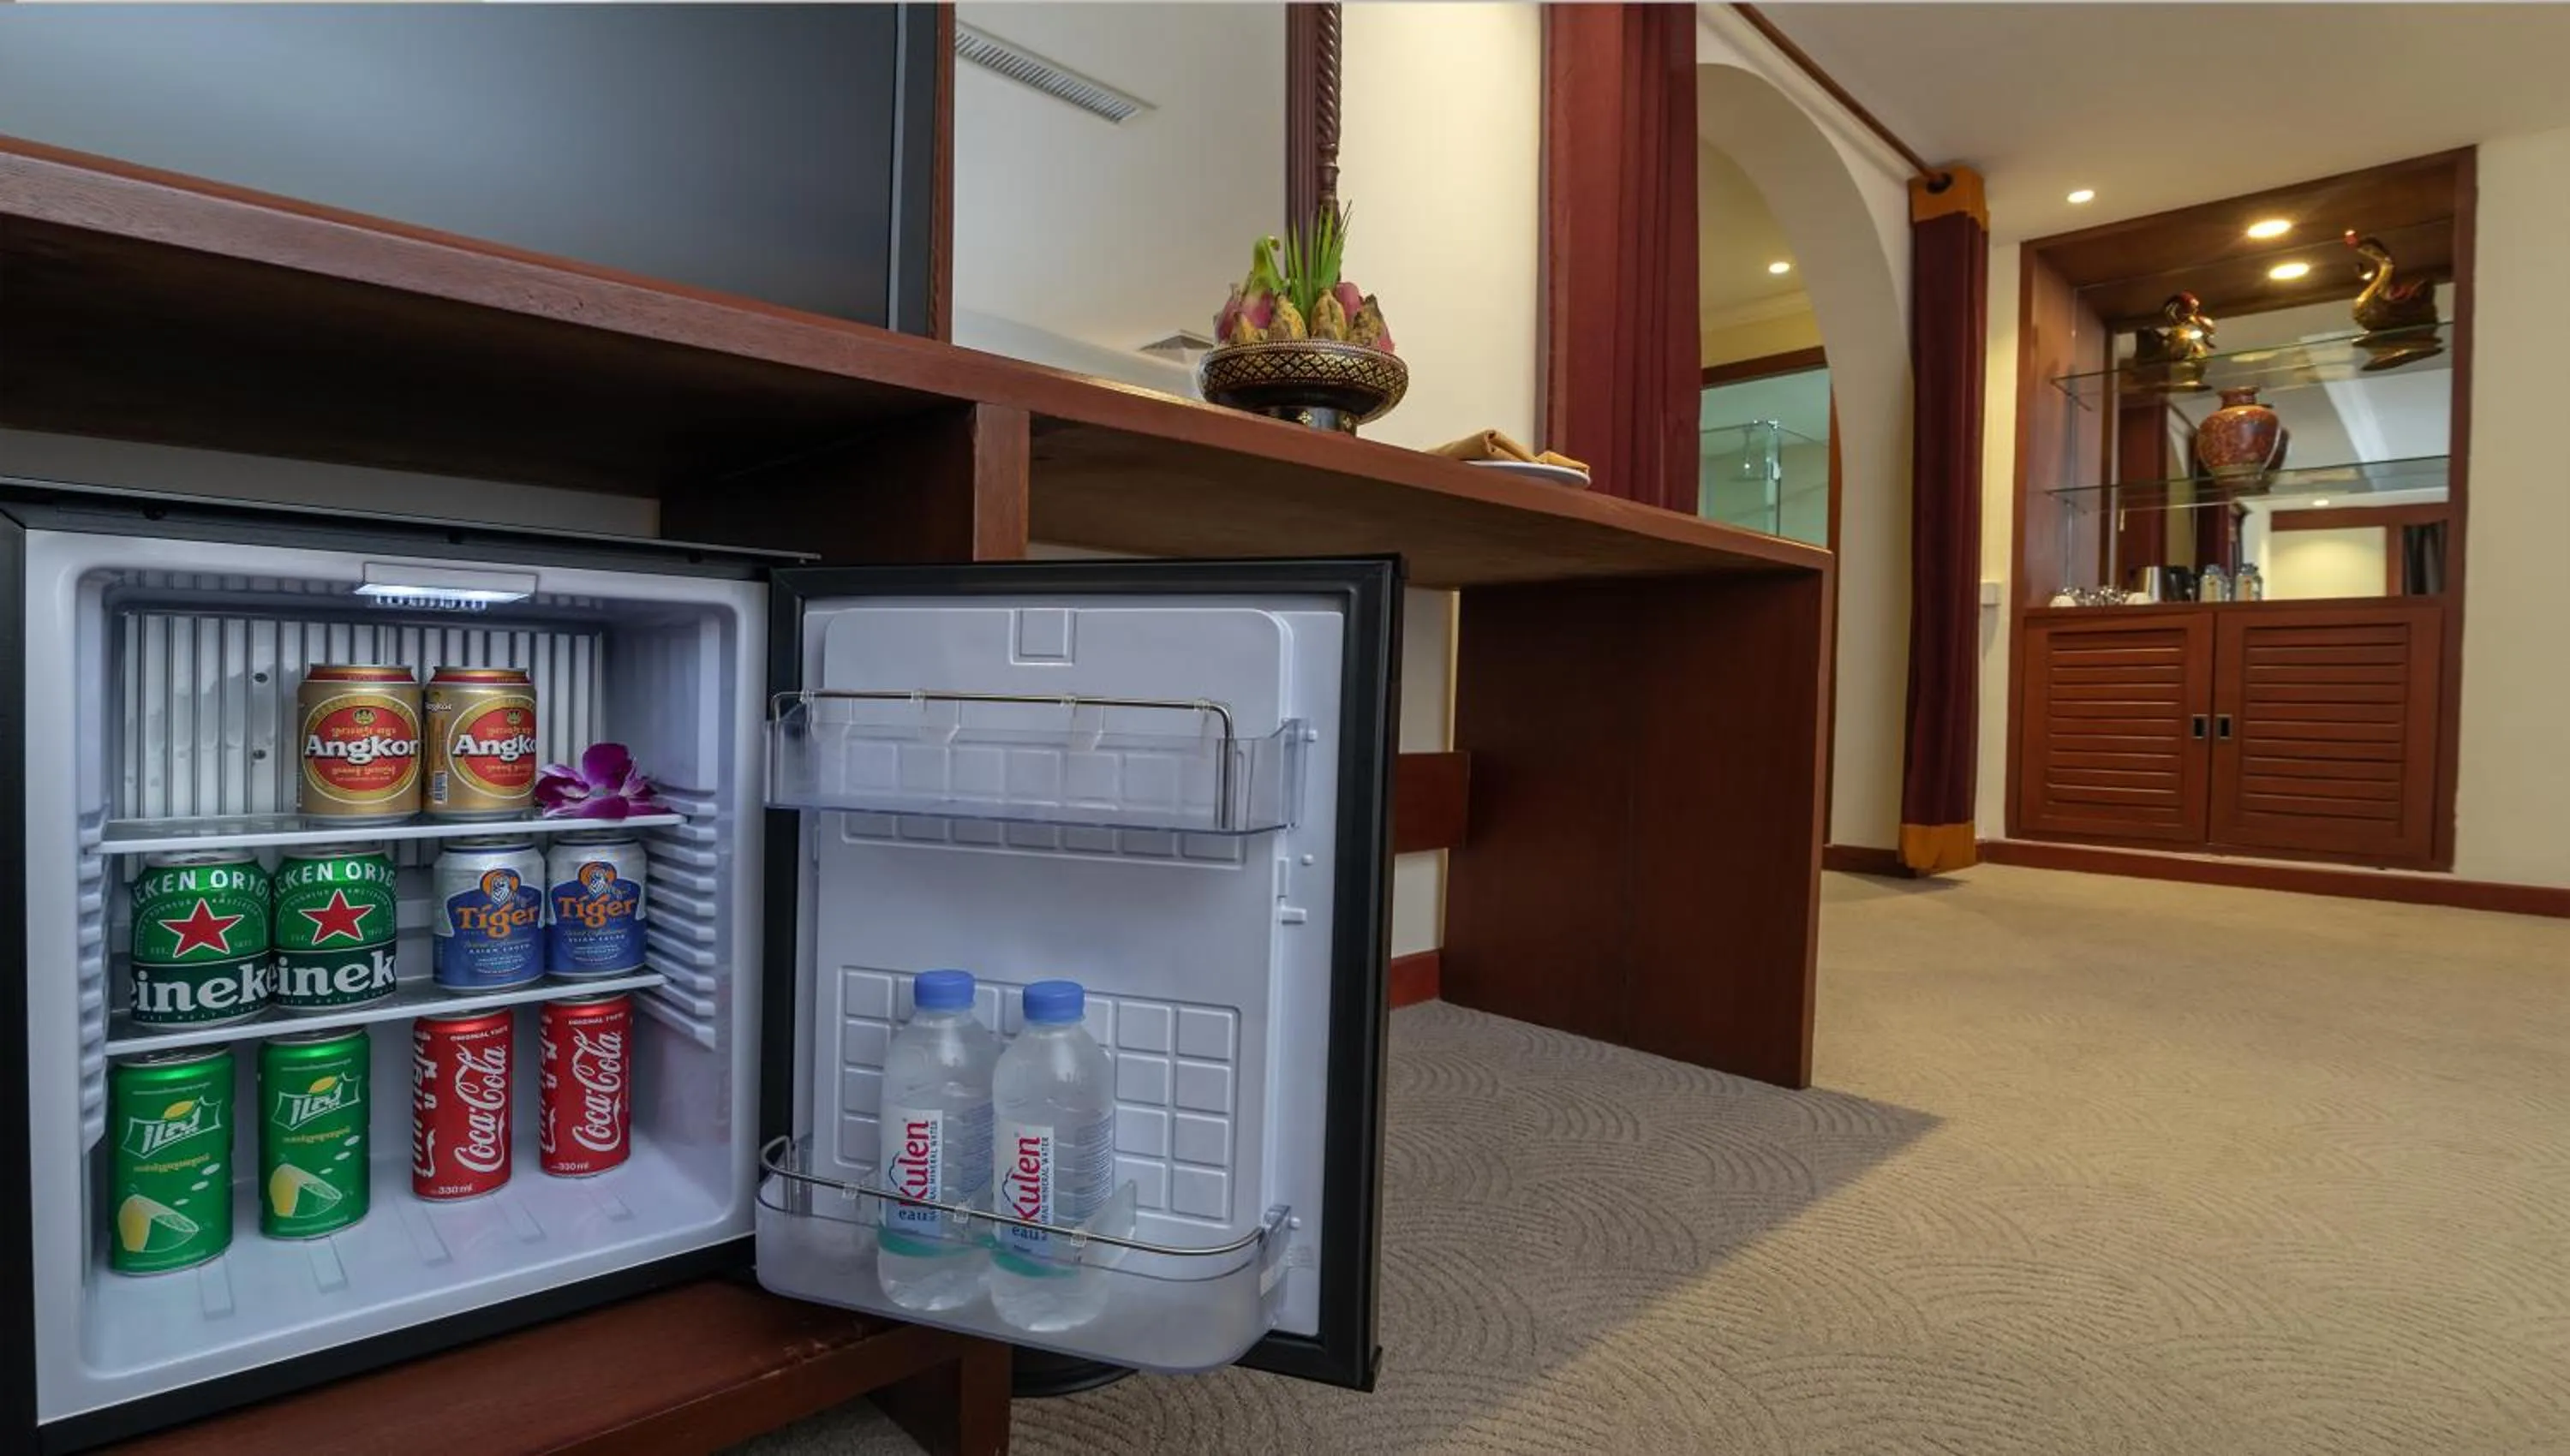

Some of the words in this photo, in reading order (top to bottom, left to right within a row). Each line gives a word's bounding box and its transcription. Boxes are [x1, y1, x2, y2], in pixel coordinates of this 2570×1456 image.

[304, 734, 419, 765] Angkor
[134, 869, 196, 908] EKEN
[345, 861, 397, 894] ORIG
[455, 902, 539, 940] Tiger
[558, 893, 637, 929] Tiger
[897, 1120, 929, 1207] Kulen
[1011, 1137, 1041, 1225] Kulen
